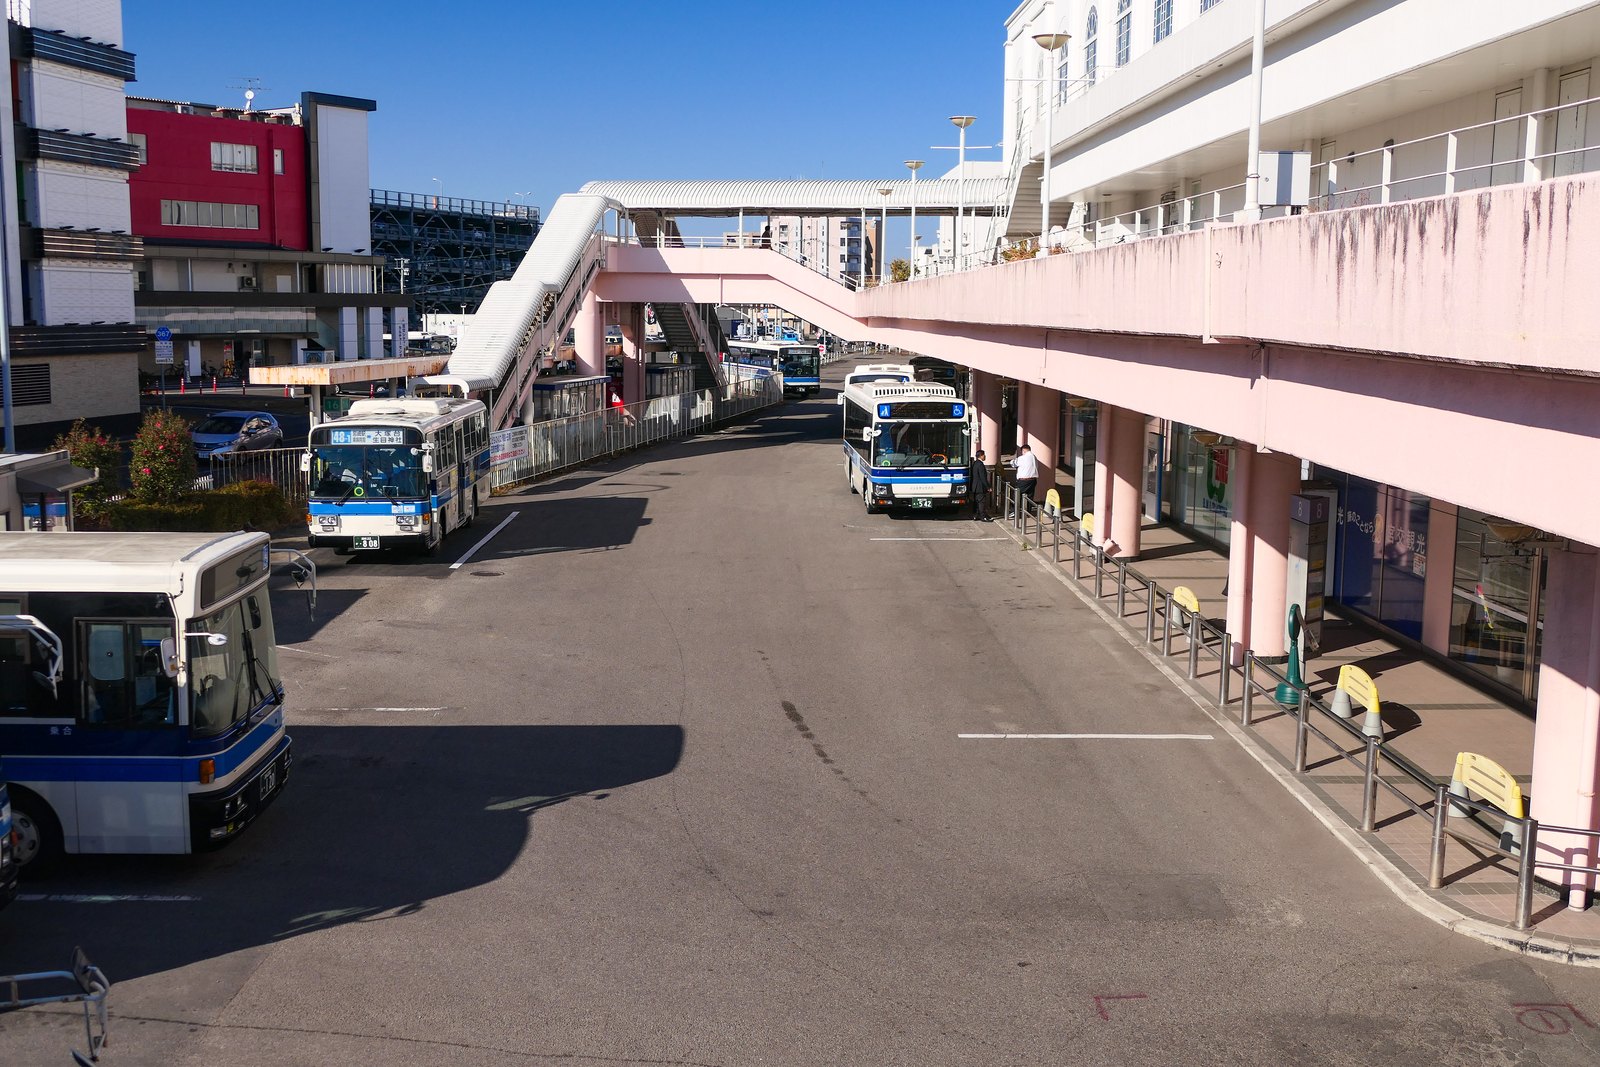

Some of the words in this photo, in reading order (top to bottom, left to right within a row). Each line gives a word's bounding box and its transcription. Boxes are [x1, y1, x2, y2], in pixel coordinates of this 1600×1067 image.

[327, 400, 339, 409] 16
[333, 431, 351, 443] 48-1
[1297, 501, 1303, 517] 8
[1316, 502, 1322, 518] 8
[362, 540, 378, 548] 808
[1386, 525, 1425, 554] 宮交観光
